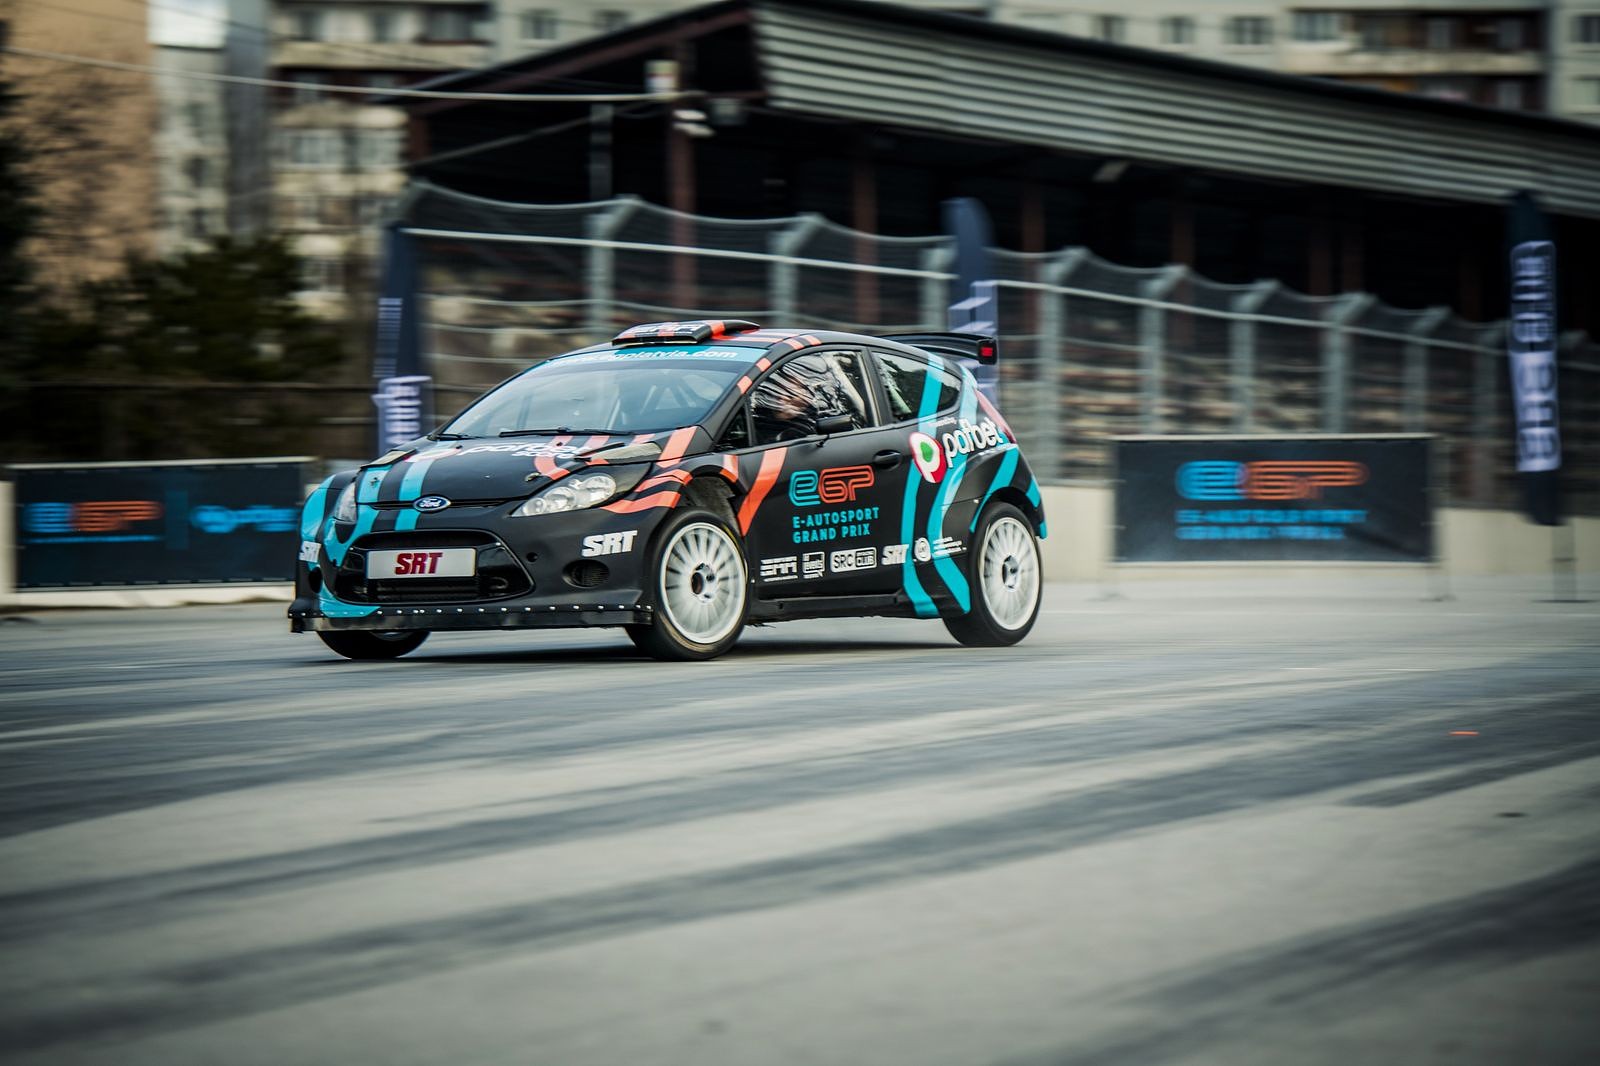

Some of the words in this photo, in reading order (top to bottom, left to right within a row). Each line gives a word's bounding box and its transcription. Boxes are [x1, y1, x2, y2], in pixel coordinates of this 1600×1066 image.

[792, 506, 880, 529] E-AUTOSPORT
[582, 530, 637, 556] SRT
[792, 527, 837, 544] GRAND
[841, 522, 871, 539] PRIX
[394, 551, 442, 575] SRT
[833, 553, 854, 569] SRC
[881, 543, 910, 566] SRT
